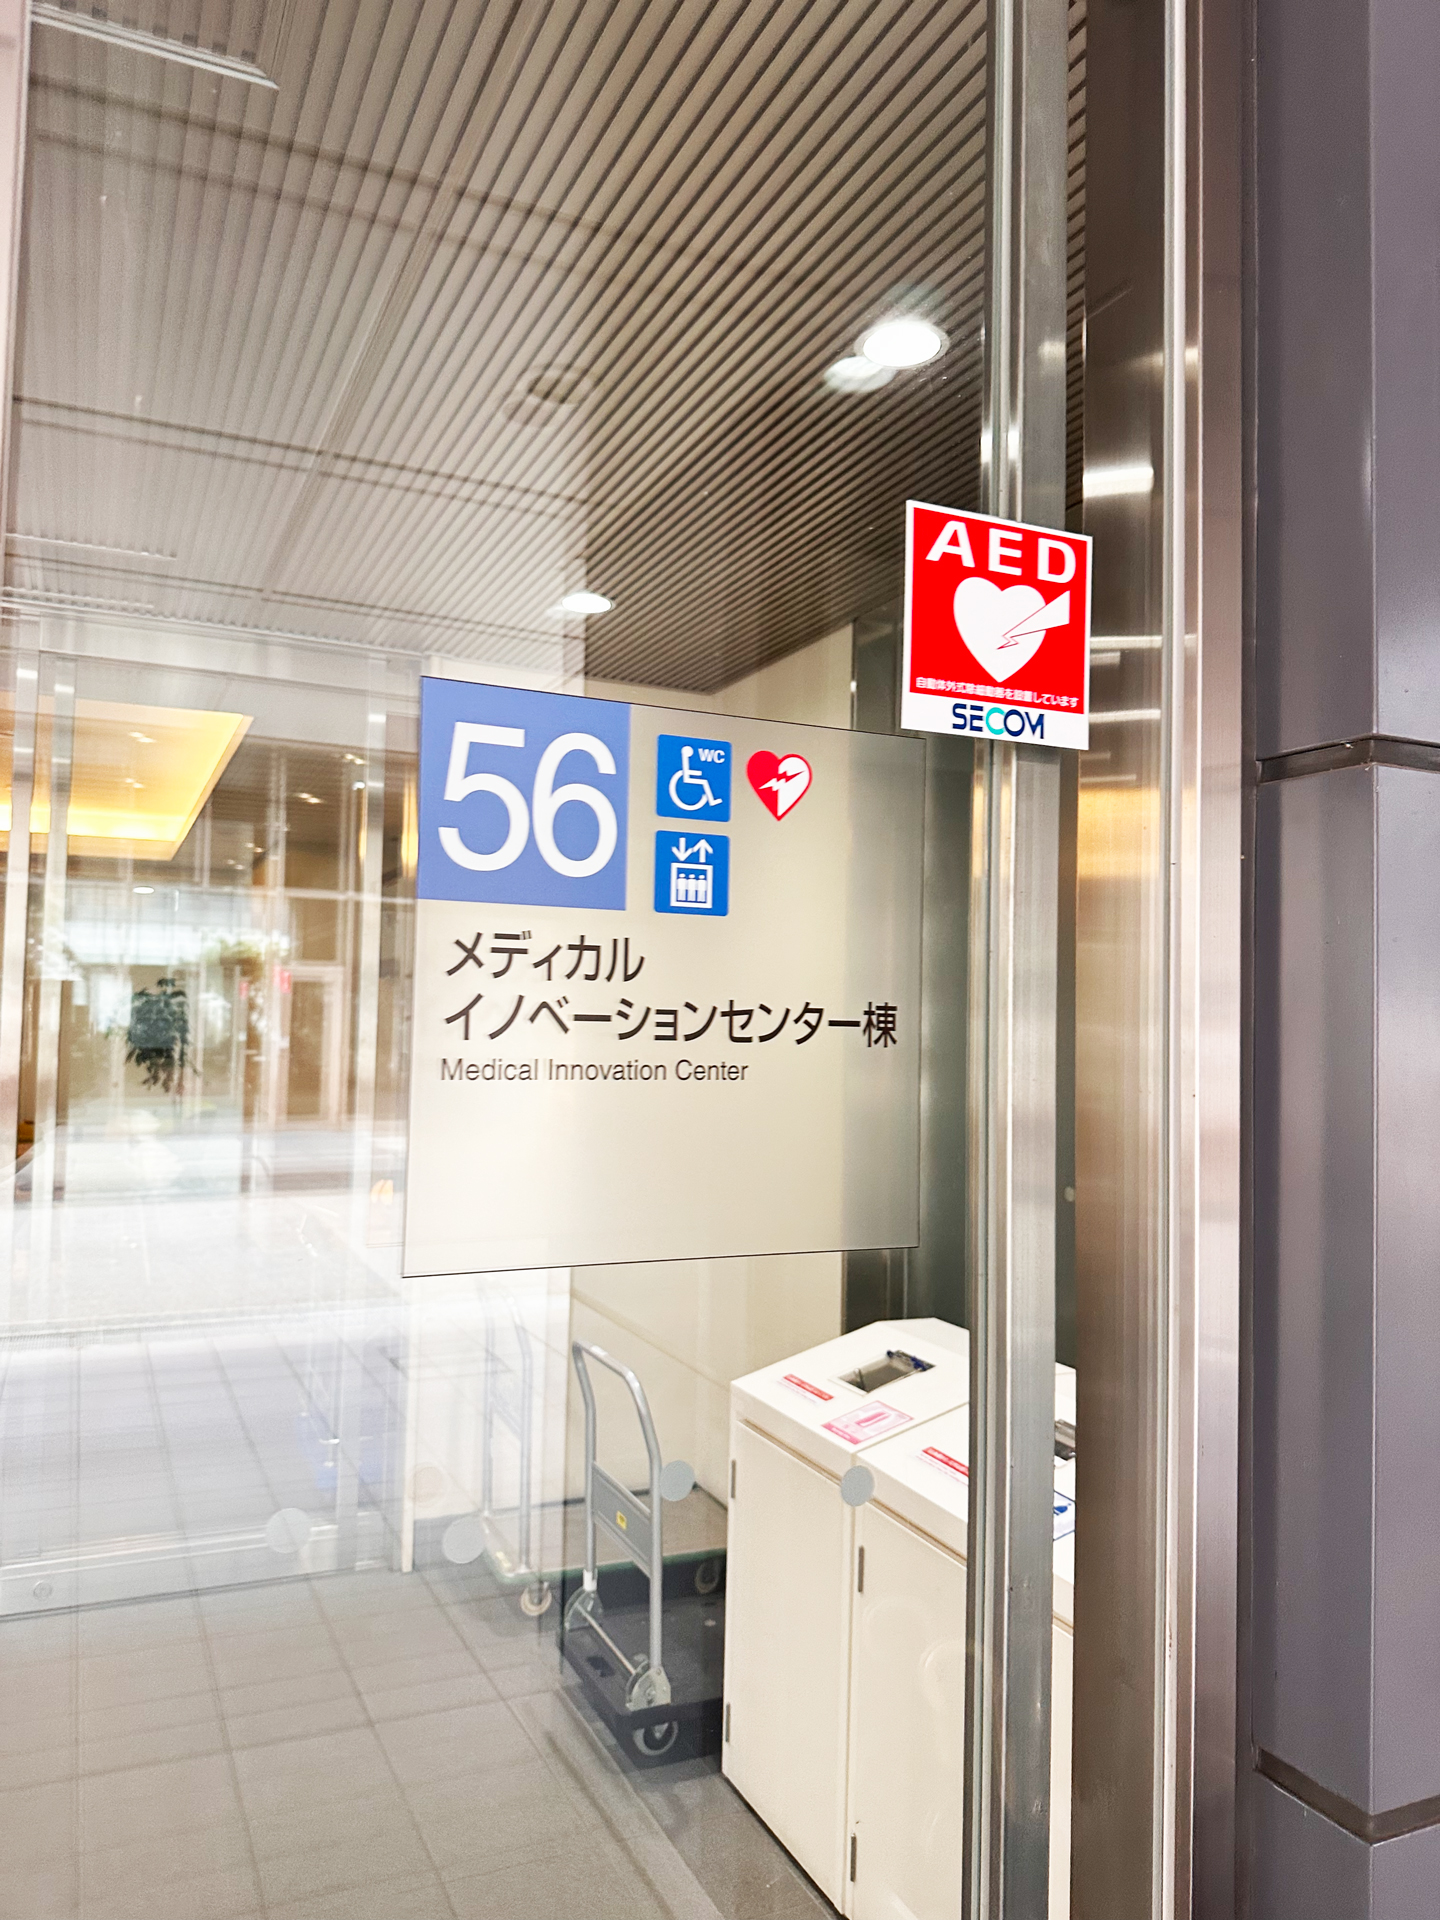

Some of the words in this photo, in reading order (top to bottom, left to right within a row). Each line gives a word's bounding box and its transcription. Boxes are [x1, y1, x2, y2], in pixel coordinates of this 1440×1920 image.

[925, 520, 1076, 583] AED
[952, 703, 1045, 739] SECOM
[698, 748, 725, 764] WC
[438, 721, 617, 877] 56
[445, 931, 645, 982] メディカル
[444, 993, 898, 1048] イノベーションセンター棟
[440, 1058, 538, 1082] Medical
[549, 1060, 667, 1082] Innovation
[674, 1060, 748, 1082] Center
